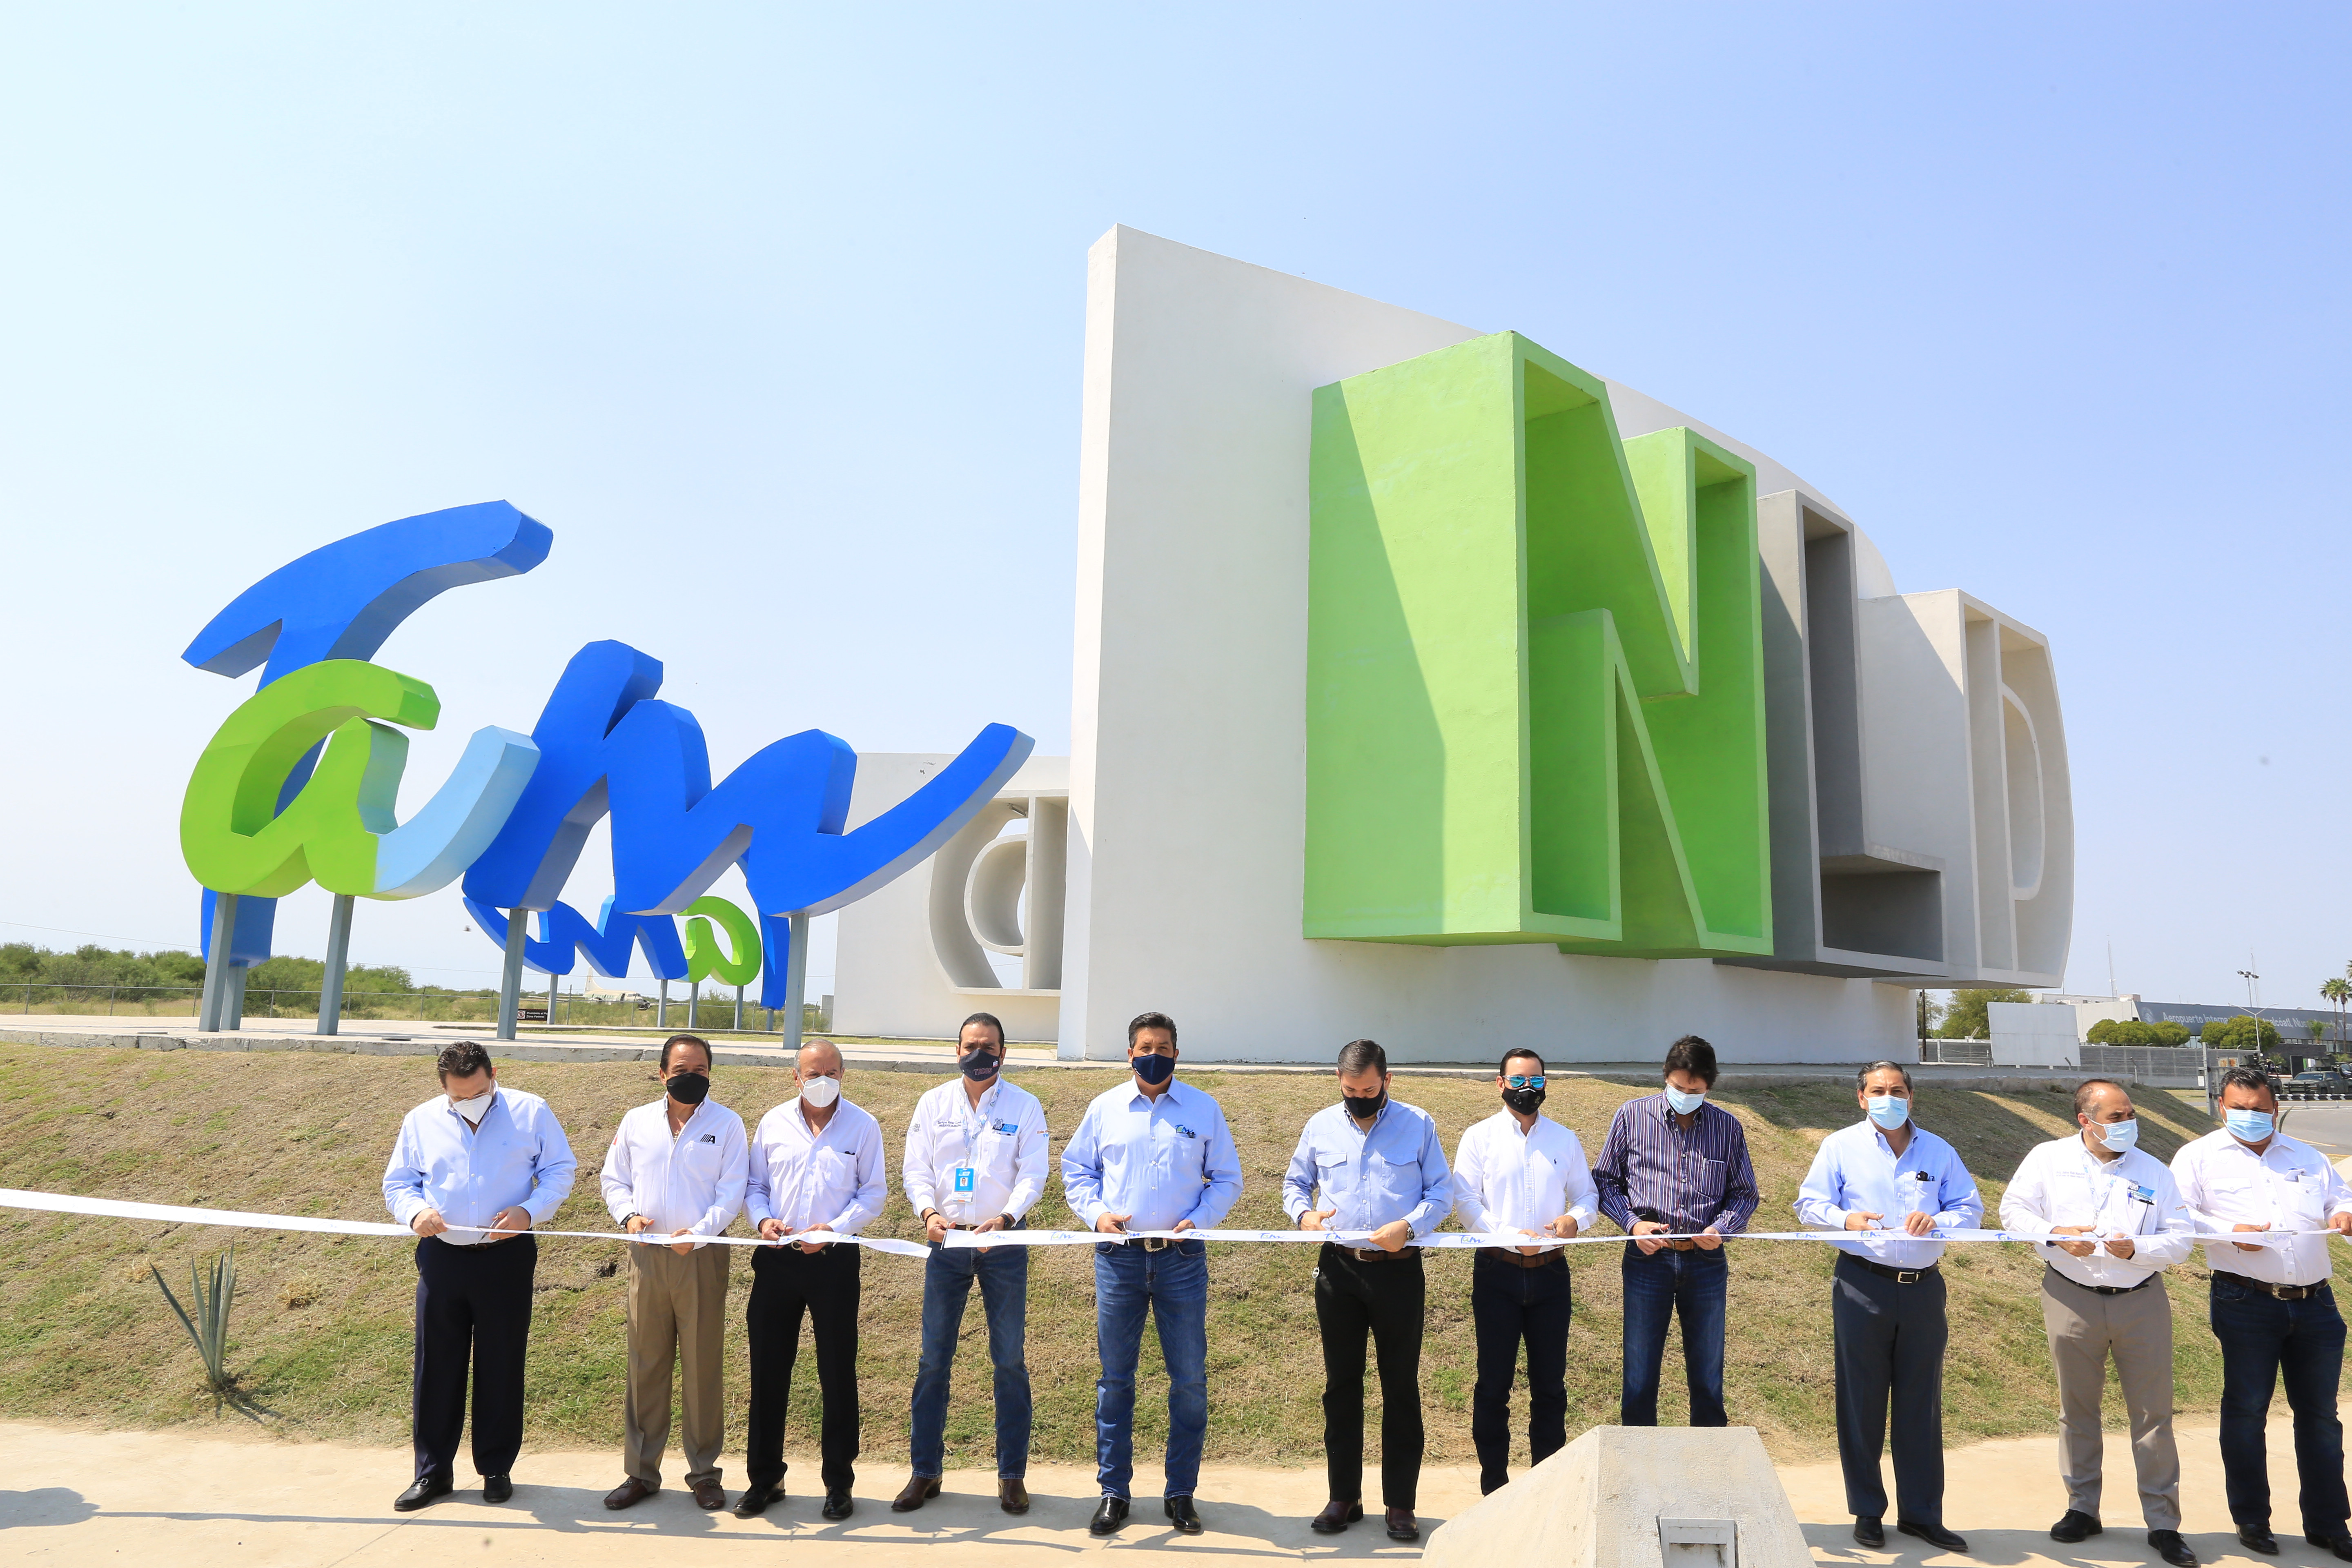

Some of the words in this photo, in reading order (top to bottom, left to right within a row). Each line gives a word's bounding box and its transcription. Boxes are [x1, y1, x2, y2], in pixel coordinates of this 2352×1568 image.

[180, 499, 1036, 966] Tam
[2163, 1012, 2204, 1026] Aeropuerto
[2203, 1014, 2230, 1025] Interna
[1175, 1124, 1194, 1133] Tam
[1050, 1231, 1076, 1241] Tam
[1459, 1234, 1486, 1244] Tam
[1929, 1229, 1956, 1239] Tam
